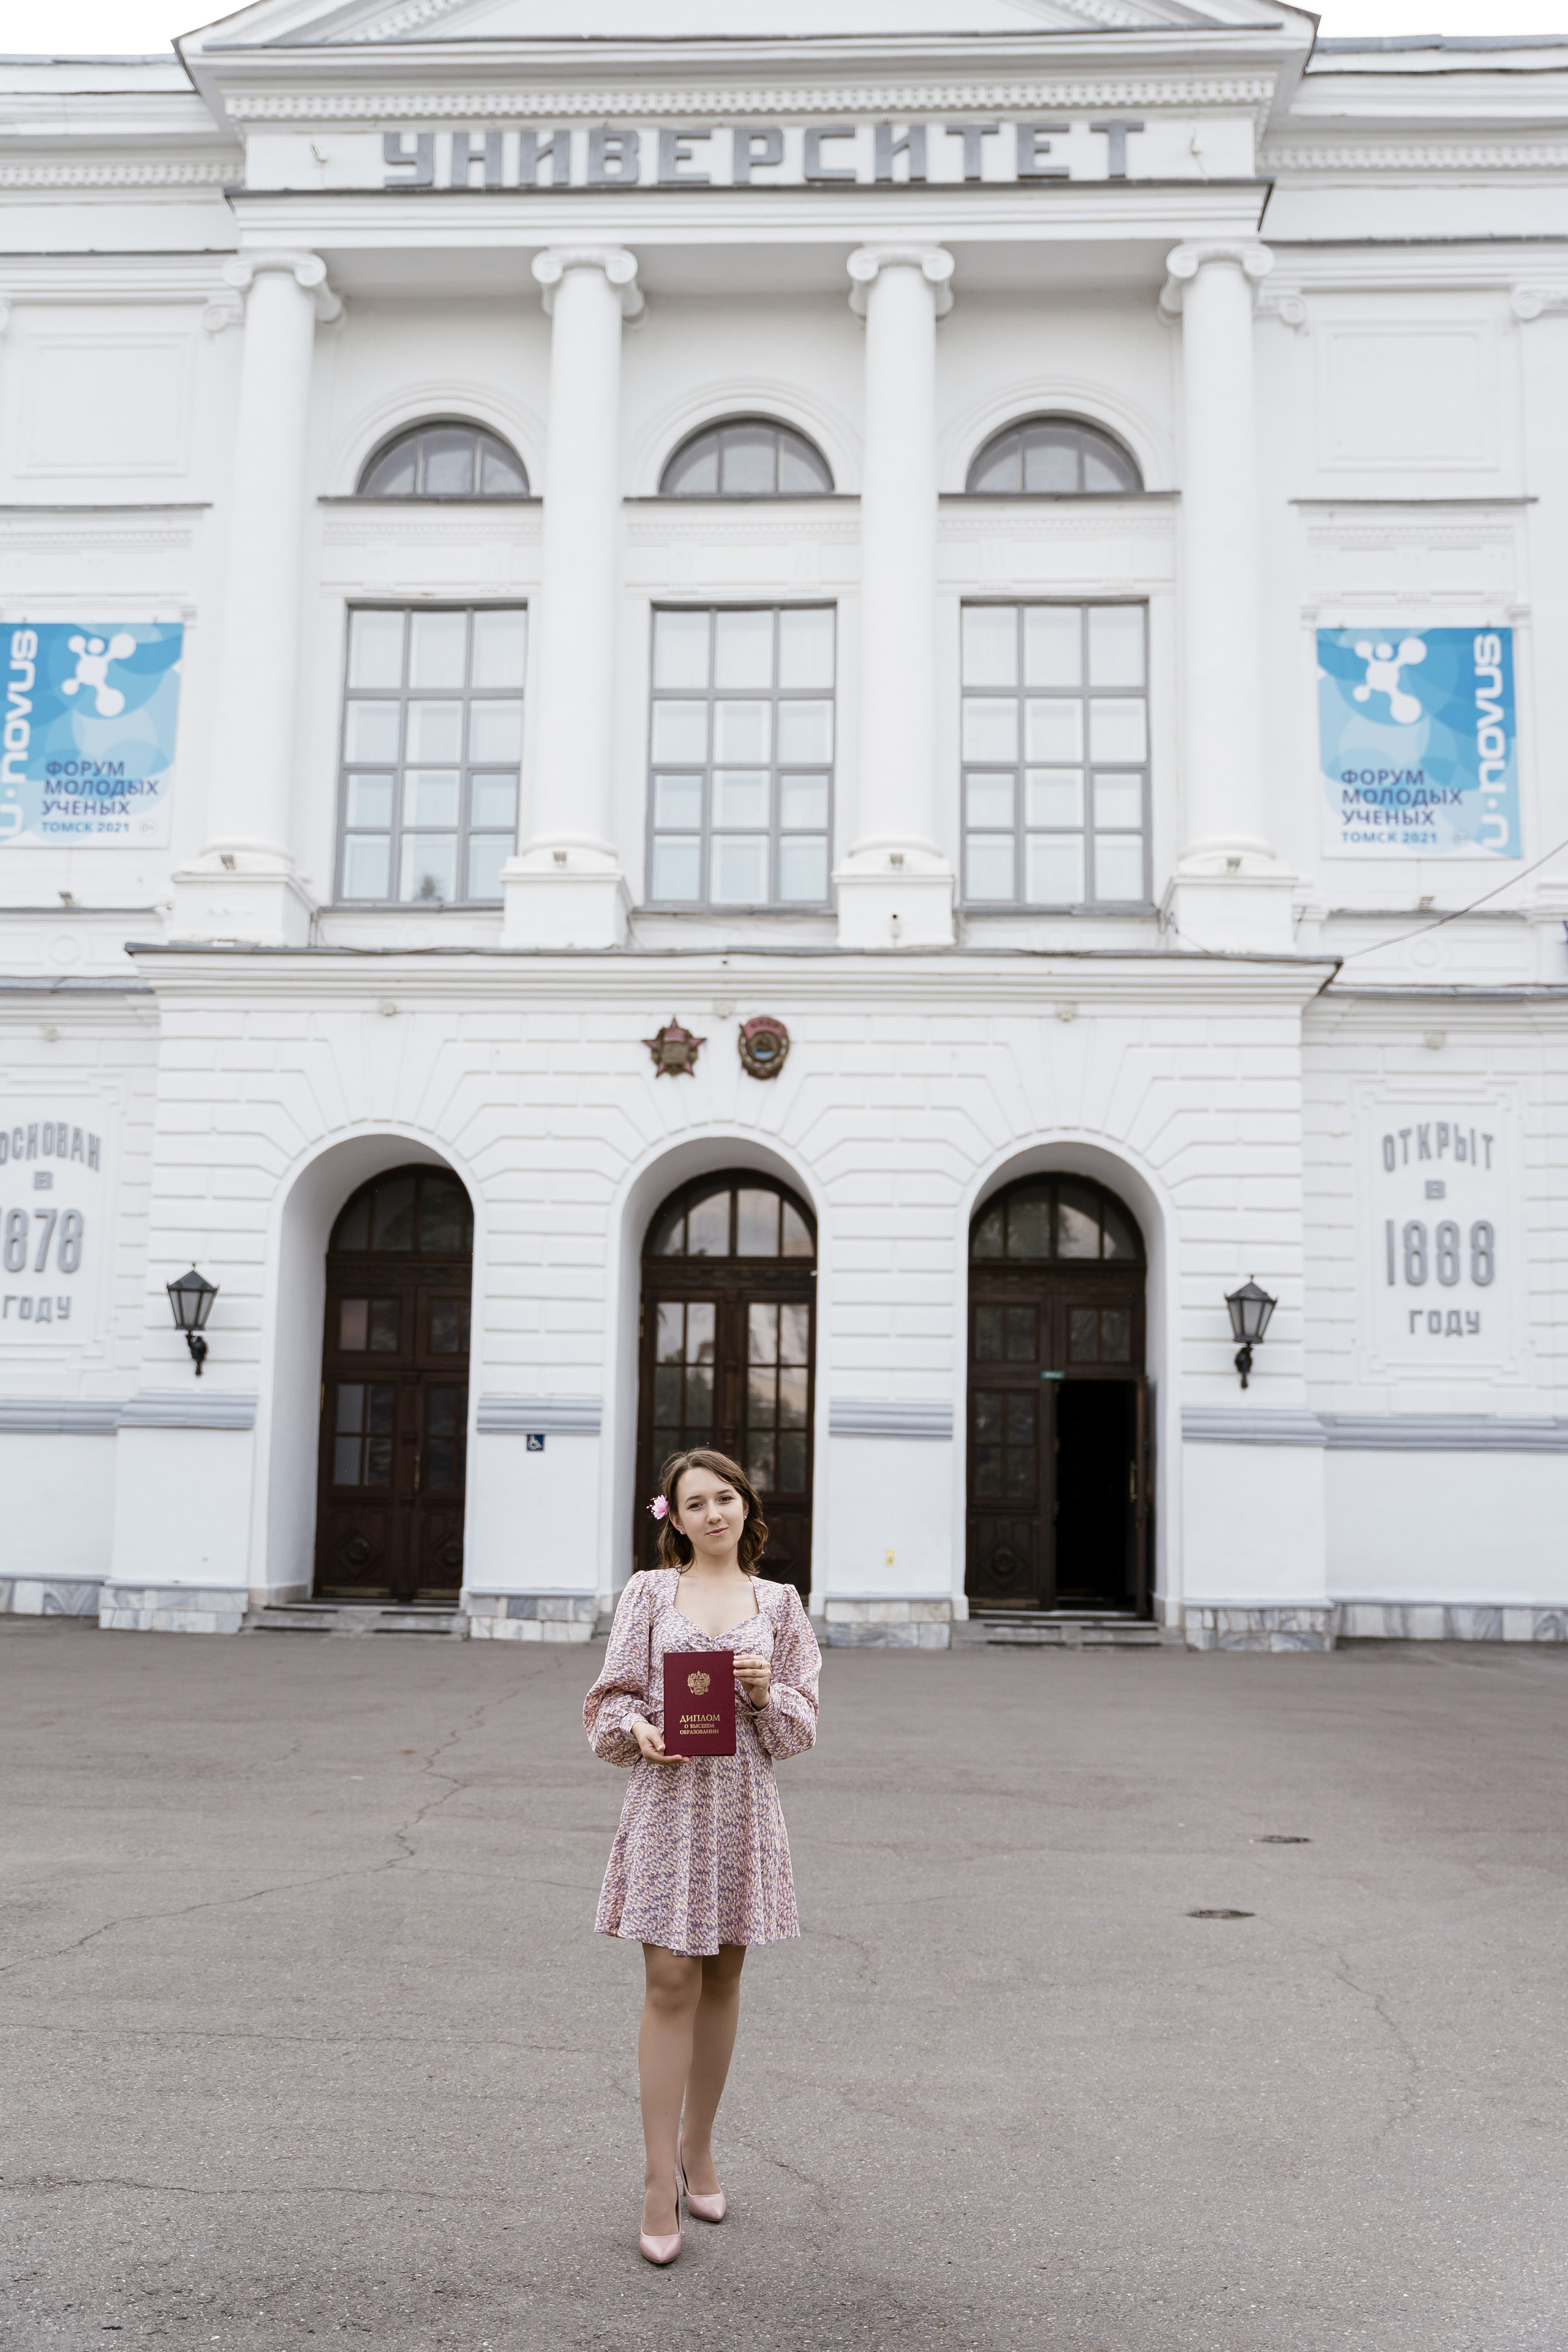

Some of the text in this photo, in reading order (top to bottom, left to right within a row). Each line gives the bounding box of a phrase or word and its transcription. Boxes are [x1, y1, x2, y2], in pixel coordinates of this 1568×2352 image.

[383, 121, 1145, 188] УНИВЕРСИТЕТ
[45, 761, 126, 777] ФОРУМ
[1341, 768, 1425, 786] ФОРУМ
[44, 780, 159, 797] МОЛОДЫХ
[1341, 788, 1463, 808] МОЛОДЫХ
[42, 800, 130, 816] УЧЕНЫХ
[1341, 810, 1435, 826] УЧЕНЫХ
[42, 822, 129, 833] ТОМСК 2021
[1342, 832, 1438, 843] ТОМСК 2021
[0, 1121, 101, 1172] ОСНОВАН
[1383, 1122, 1493, 1171] ОТКРЫТ
[34, 1171, 53, 1189] В
[0, 1208, 84, 1273] 878
[1385, 1219, 1494, 1286] 1888
[3, 1295, 70, 1323] ГОДУ
[1410, 1310, 1480, 1336] ГОДУ
[679, 1714, 721, 1724] ДИПЛОМ
